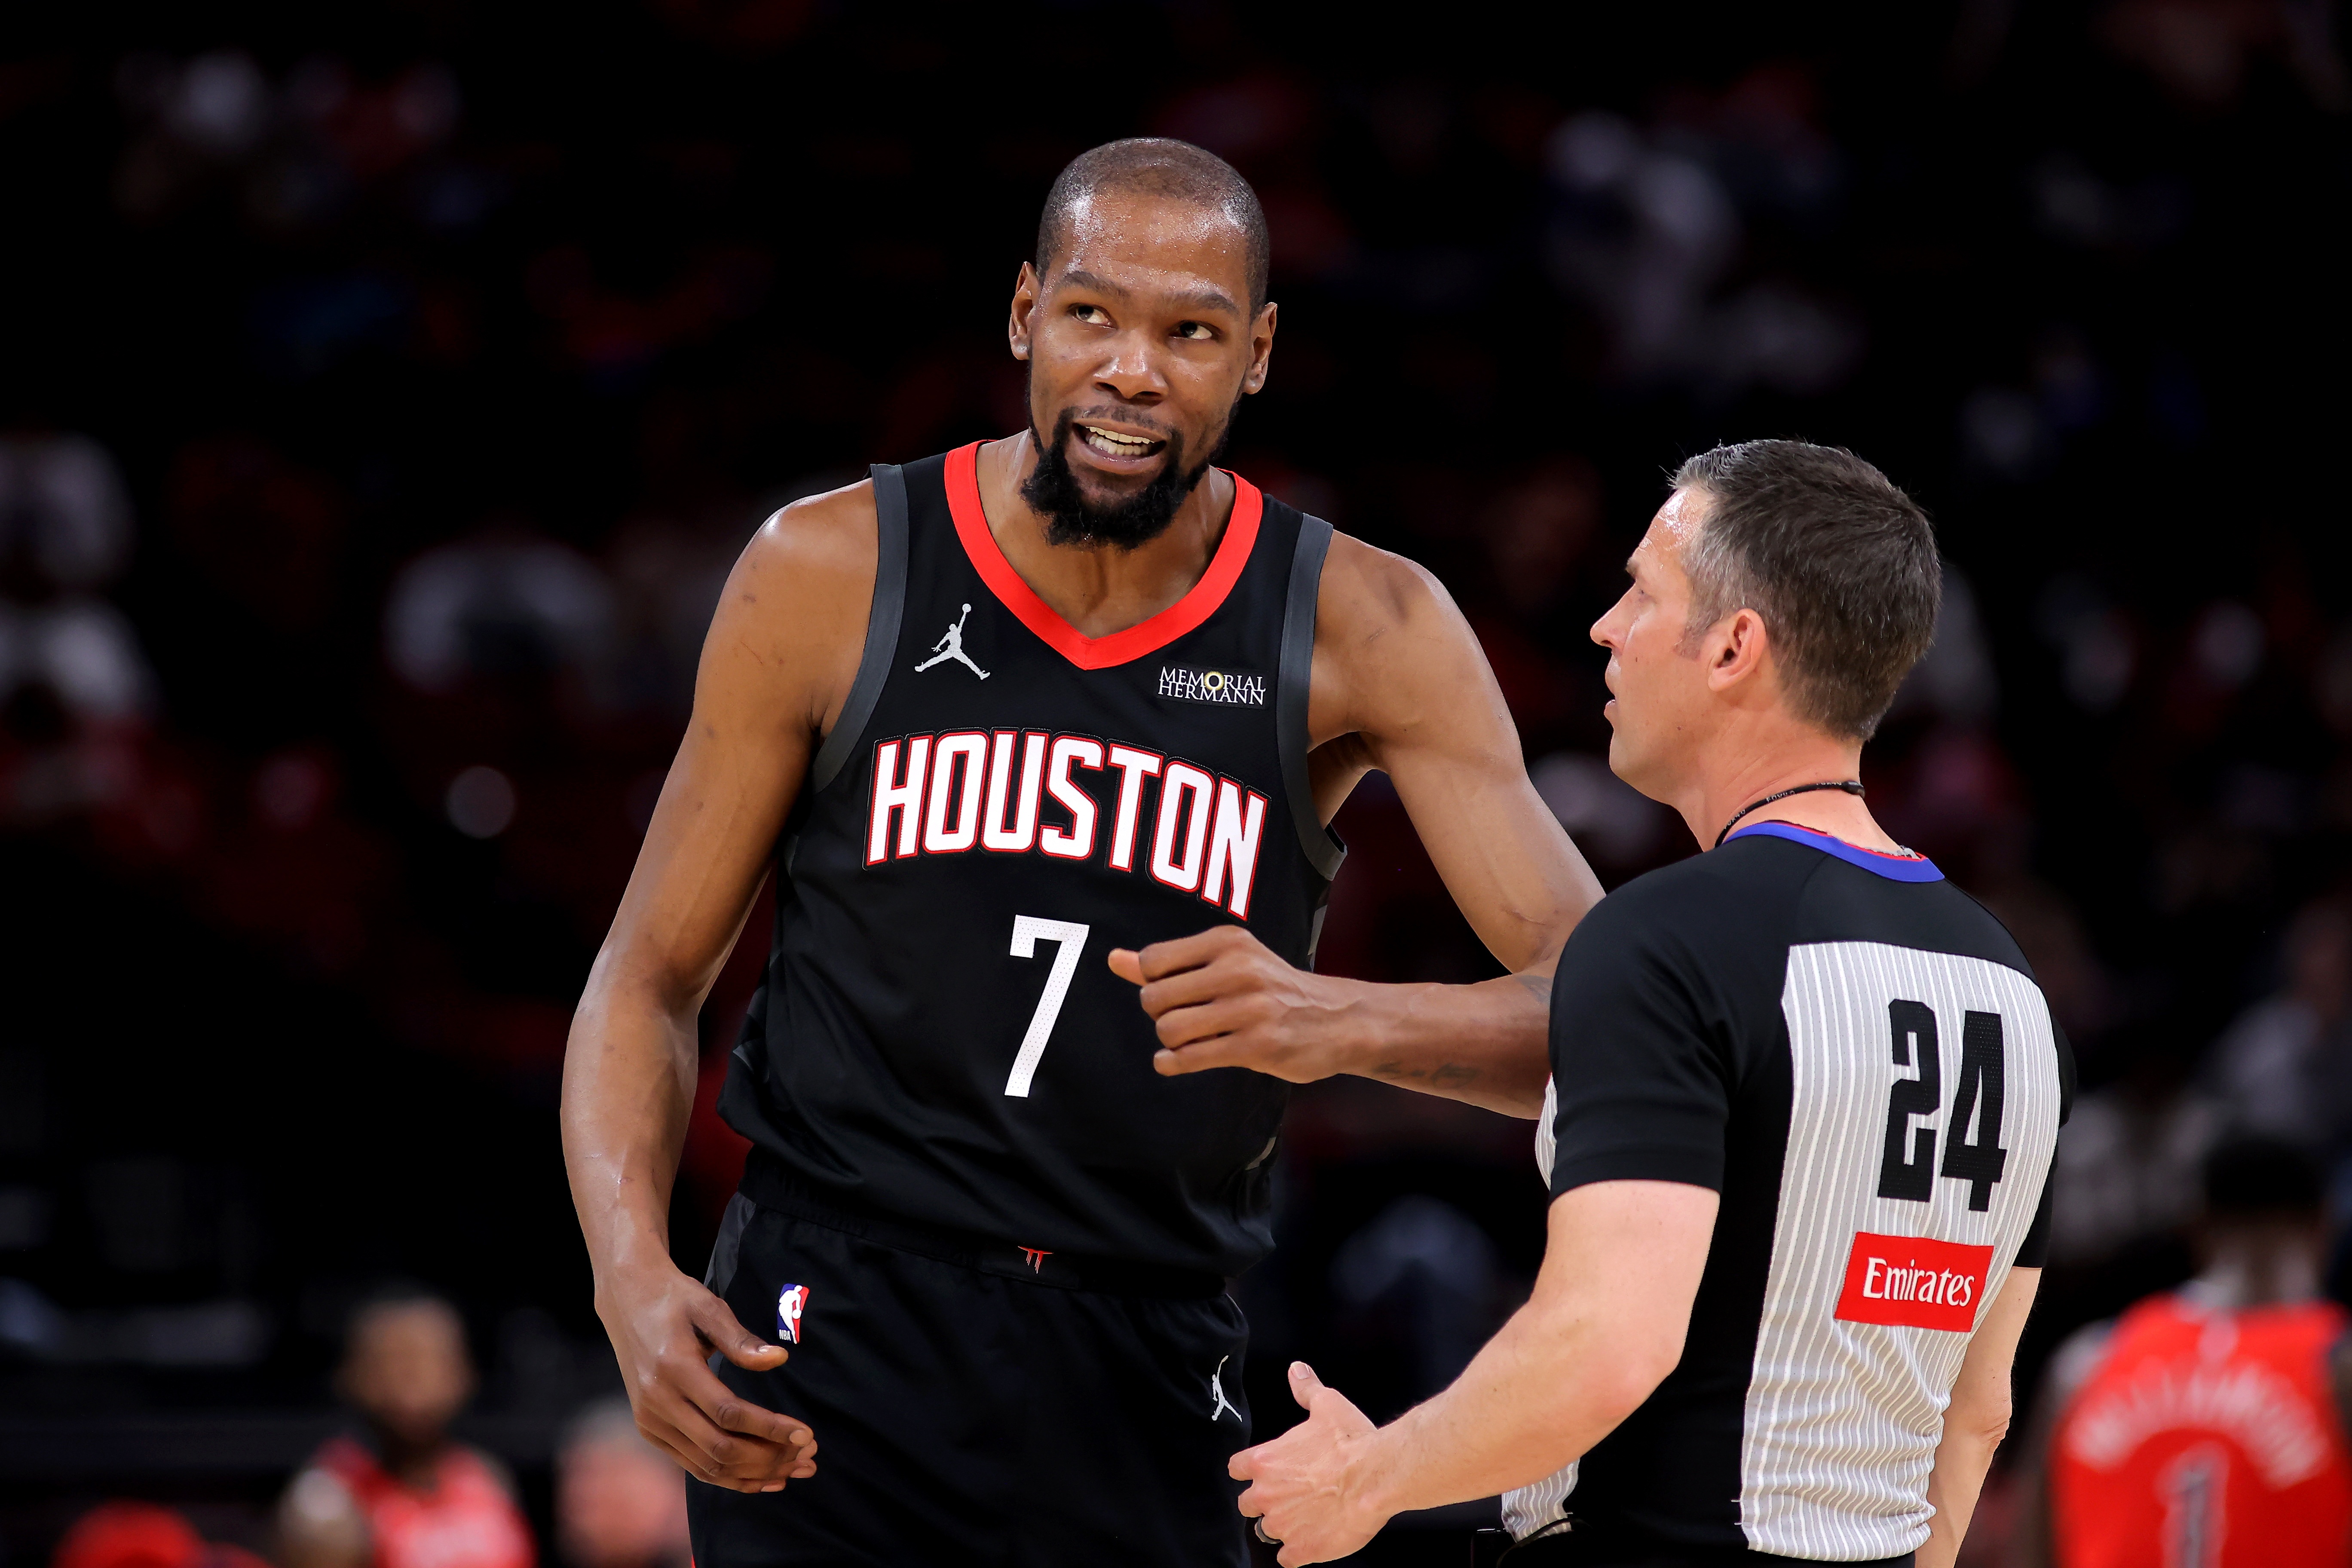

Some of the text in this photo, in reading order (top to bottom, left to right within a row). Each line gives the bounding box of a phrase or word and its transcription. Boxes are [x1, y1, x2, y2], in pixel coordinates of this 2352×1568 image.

[1158, 679, 1265, 705] HERMANN
[1159, 666, 1266, 692] MEMORIAL
[866, 730, 1268, 922] HOUSTON
[1004, 914, 1090, 1098] 7
[1877, 998, 2007, 1212] 24
[1862, 1256, 1975, 1307] Emirates
[778, 1329, 791, 1341] NBA
